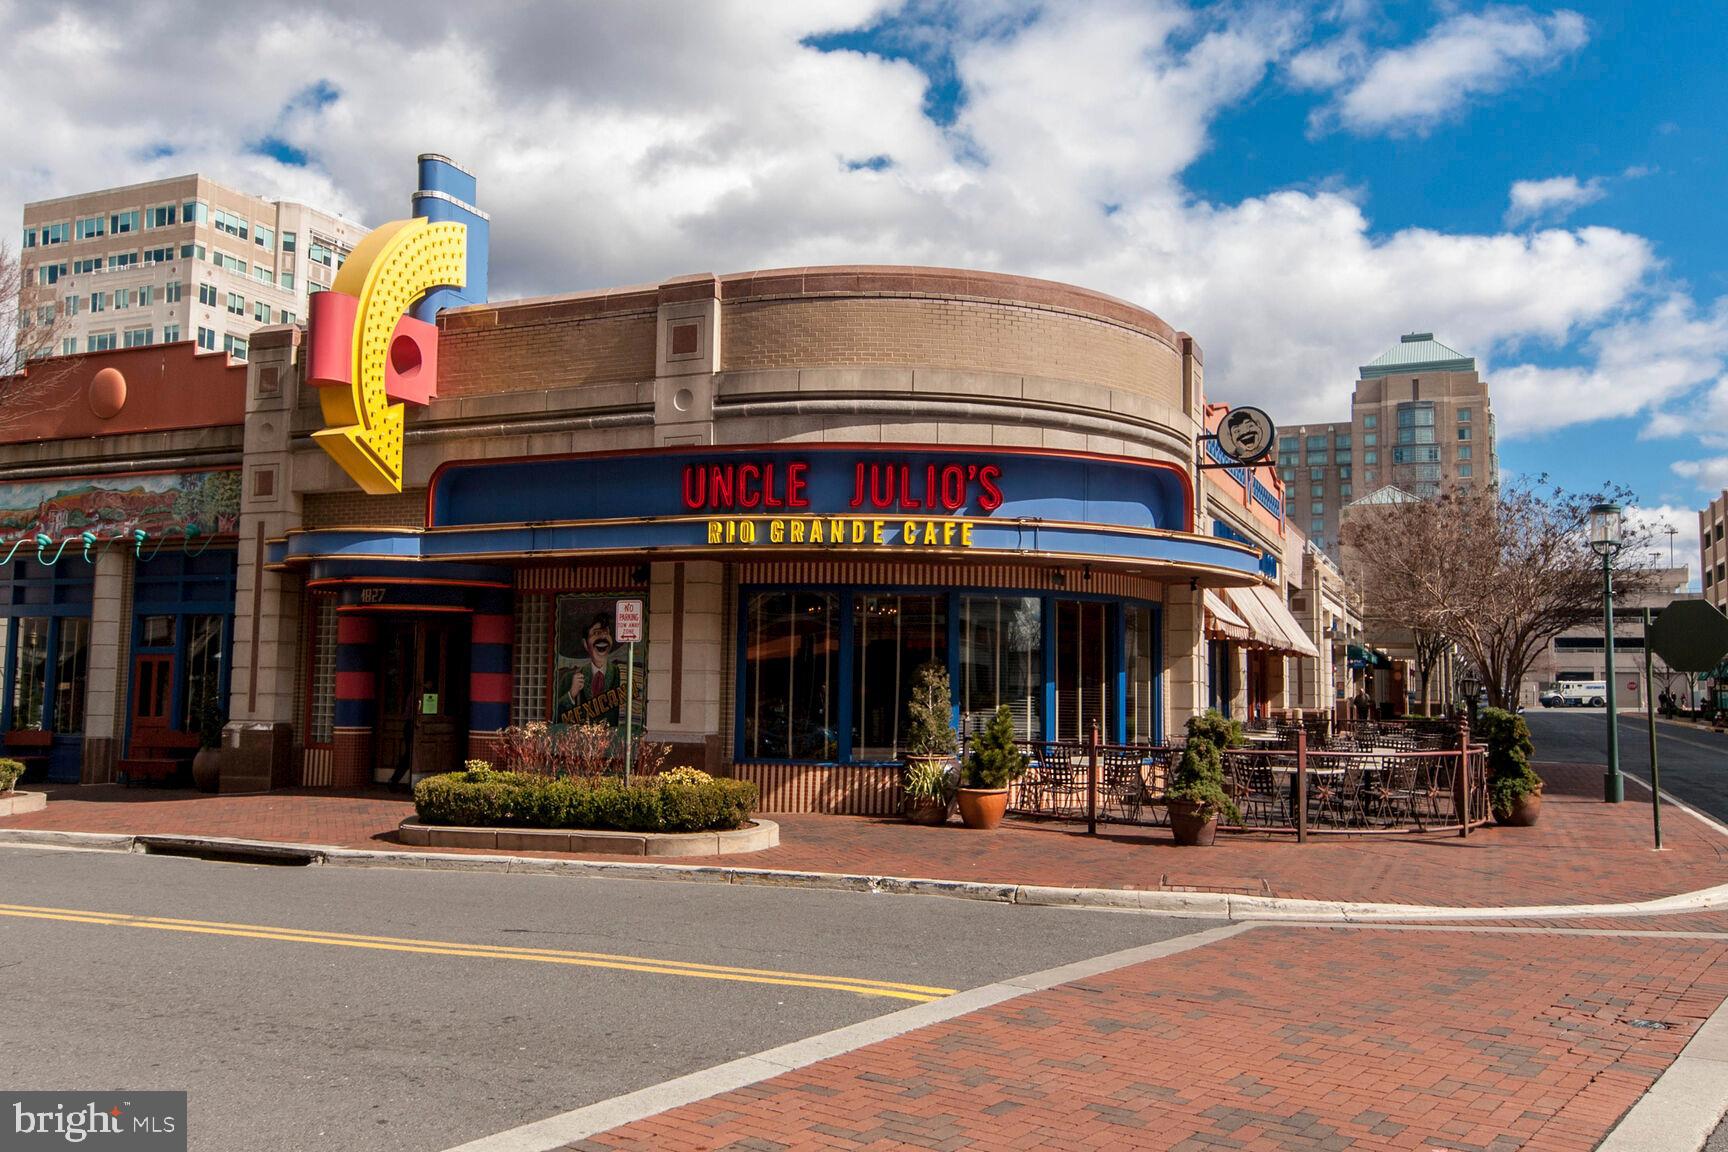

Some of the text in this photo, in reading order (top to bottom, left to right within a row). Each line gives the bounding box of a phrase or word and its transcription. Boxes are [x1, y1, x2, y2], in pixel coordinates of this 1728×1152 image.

[683, 461, 1004, 511] UNCLE JULIO'S
[708, 518, 974, 546] RIO GRANDE CAFE
[361, 588, 386, 602] 1827
[624, 604, 634, 612] NO
